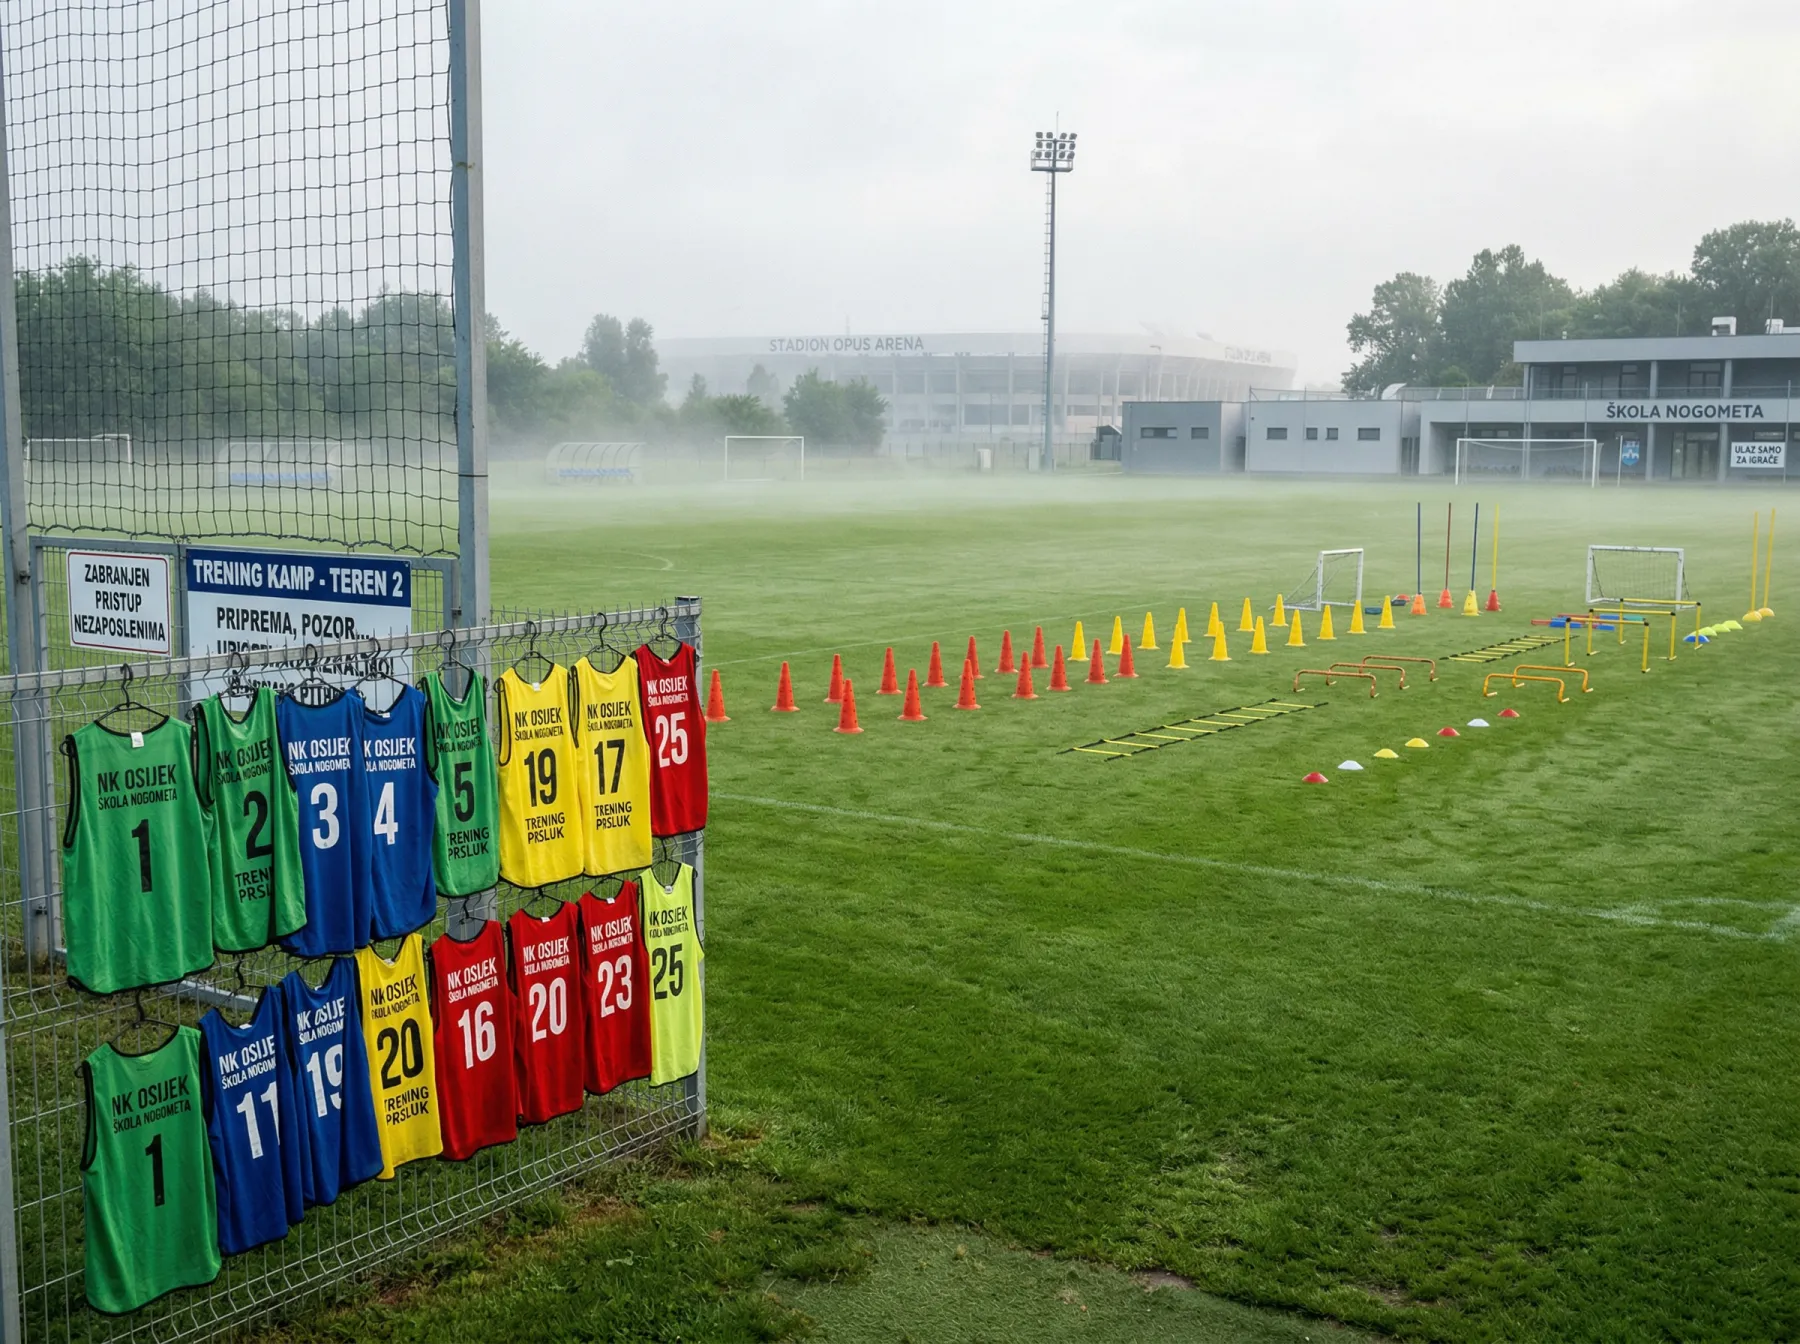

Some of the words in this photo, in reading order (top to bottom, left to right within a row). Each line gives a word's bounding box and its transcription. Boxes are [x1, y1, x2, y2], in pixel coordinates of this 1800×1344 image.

[769, 338, 829, 352] STADION
[833, 337, 871, 352] OPUS
[874, 336, 924, 351] ARENA
[1606, 402, 1661, 419] ŠKOLA
[1665, 404, 1764, 419] NOGOMETA
[1735, 445, 1756, 454] ULAZ
[1757, 445, 1782, 454] SAMO
[1736, 455, 1747, 464] ZA
[1749, 454, 1779, 465] IGRAČE
[84, 564, 150, 588] ZABRANJEN
[193, 559, 263, 588] TRENING
[267, 563, 314, 591] KAMP
[330, 567, 388, 597] TEREN
[392, 571, 403, 598] 2
[95, 590, 142, 613] PRISTUP
[74, 614, 166, 642] NEZAPOSLENIMA
[216, 606, 297, 642] PRIPREMA,
[659, 675, 688, 694] OSIJEK
[515, 711, 528, 730] NK
[530, 707, 562, 726] OSIJEK
[587, 703, 599, 720] NK
[600, 700, 632, 718] OSIJEK
[436, 721, 451, 739] NK
[655, 711, 688, 768] 25
[215, 750, 234, 770] NK
[288, 740, 308, 760] NK
[310, 737, 351, 759] OSIJEK
[364, 740, 372, 758] K
[374, 737, 416, 757] OSIJEK
[97, 770, 120, 796] NK
[124, 764, 177, 790] OSIJEK
[524, 748, 557, 807] 19
[594, 738, 625, 796] 17
[131, 788, 178, 806] NOGOMETA
[454, 761, 474, 823] 5
[310, 782, 340, 850] 3
[374, 782, 398, 846] 4
[525, 812, 565, 831] TRENING
[594, 801, 632, 817] TRENING
[596, 815, 631, 830] PRSLUK
[243, 790, 273, 860] 2
[527, 827, 565, 845] PRSLUK
[132, 818, 153, 893] 1
[590, 924, 603, 943] NK
[523, 944, 536, 964] NK
[537, 936, 570, 960] OSIJEK
[448, 969, 462, 991] NK
[652, 943, 683, 1001] 25
[371, 987, 386, 1006] NK
[597, 955, 632, 1018] 23
[296, 1010, 311, 1032] NK
[315, 996, 345, 1026] OSIJE
[529, 977, 567, 1043] 20
[458, 1000, 496, 1070] 16
[219, 1050, 240, 1075] NK
[241, 1034, 275, 1066] OSIJE
[376, 1018, 424, 1090] 20
[221, 1069, 248, 1090] ŠKOLA
[306, 1043, 343, 1118] 19
[112, 1091, 134, 1118] NK
[138, 1074, 190, 1110] OSIJEK
[113, 1115, 142, 1134] ŠKOLA
[143, 1099, 192, 1125] NOGOMETA
[236, 1080, 280, 1160] 11
[386, 1101, 429, 1126] PRSLUK
[145, 1133, 165, 1208] 1
